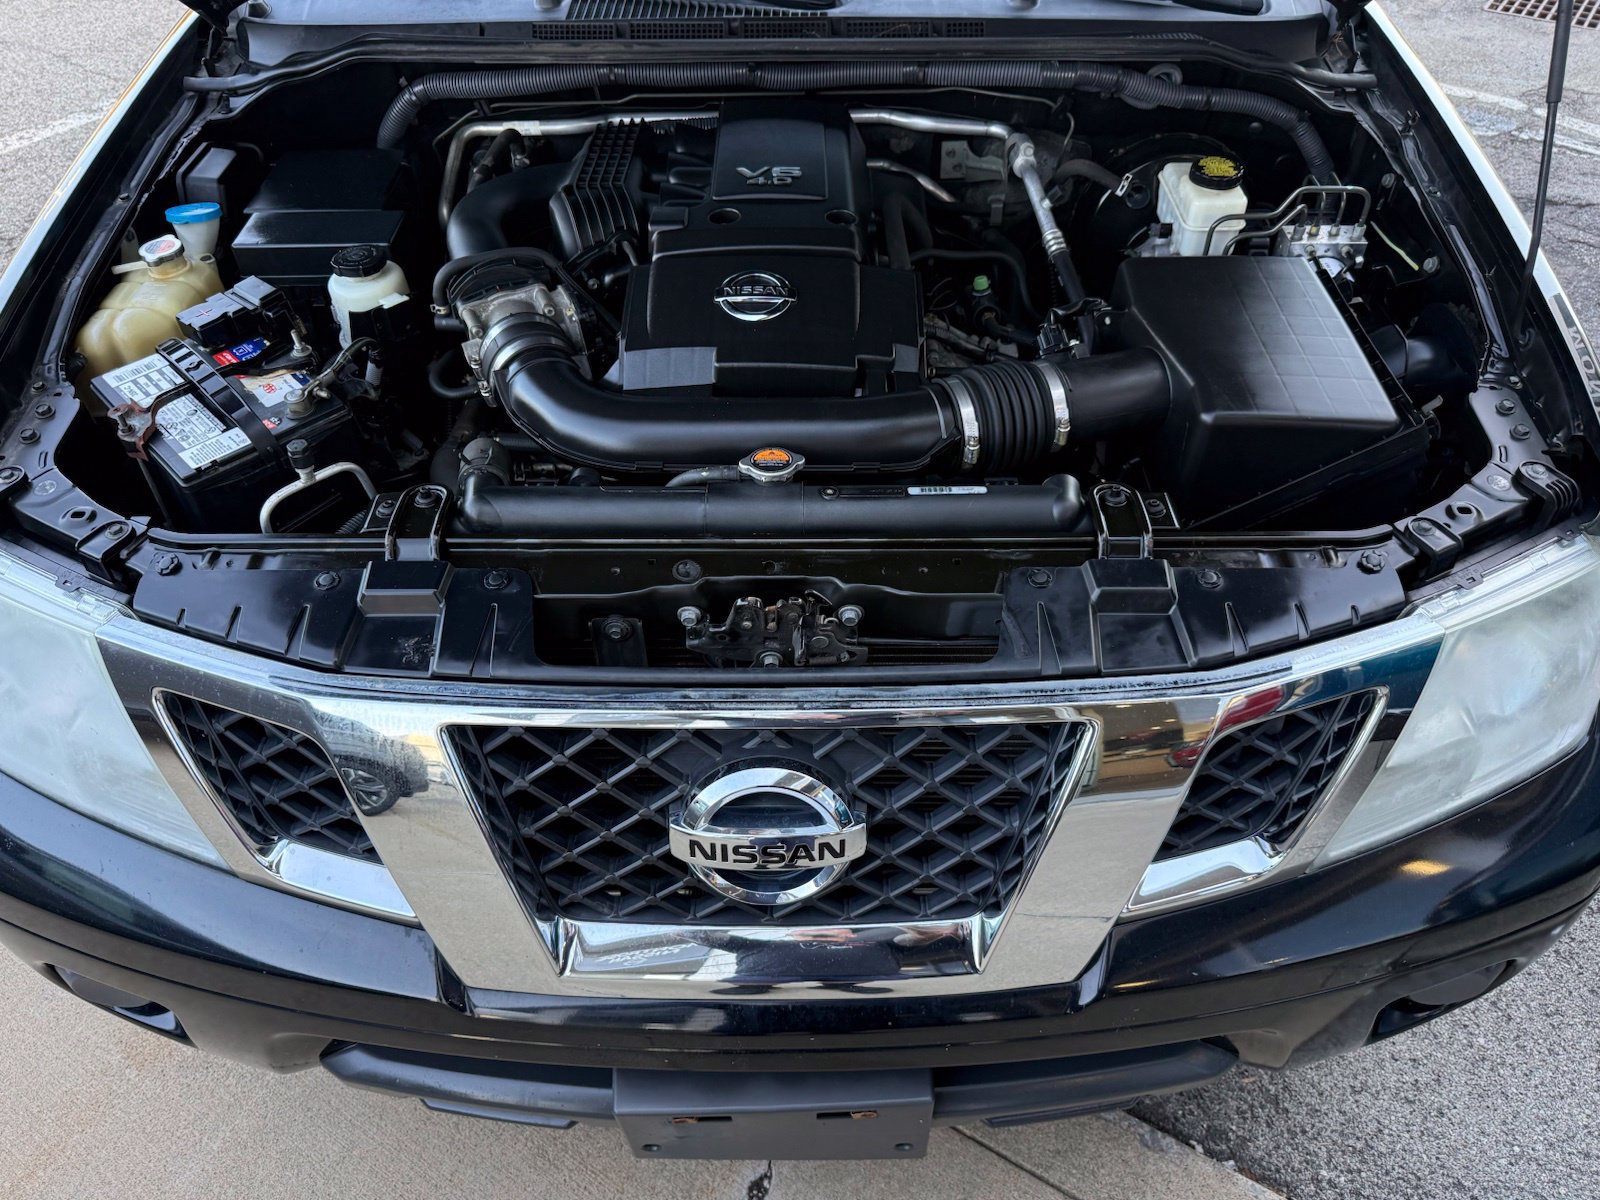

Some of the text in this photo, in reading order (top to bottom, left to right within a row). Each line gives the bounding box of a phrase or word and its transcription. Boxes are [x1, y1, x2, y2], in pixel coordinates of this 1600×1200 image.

[735, 166, 803, 178] V6
[747, 177, 792, 185] 4.0
[723, 286, 789, 296] NISSAN
[688, 838, 847, 864] NISSAN
